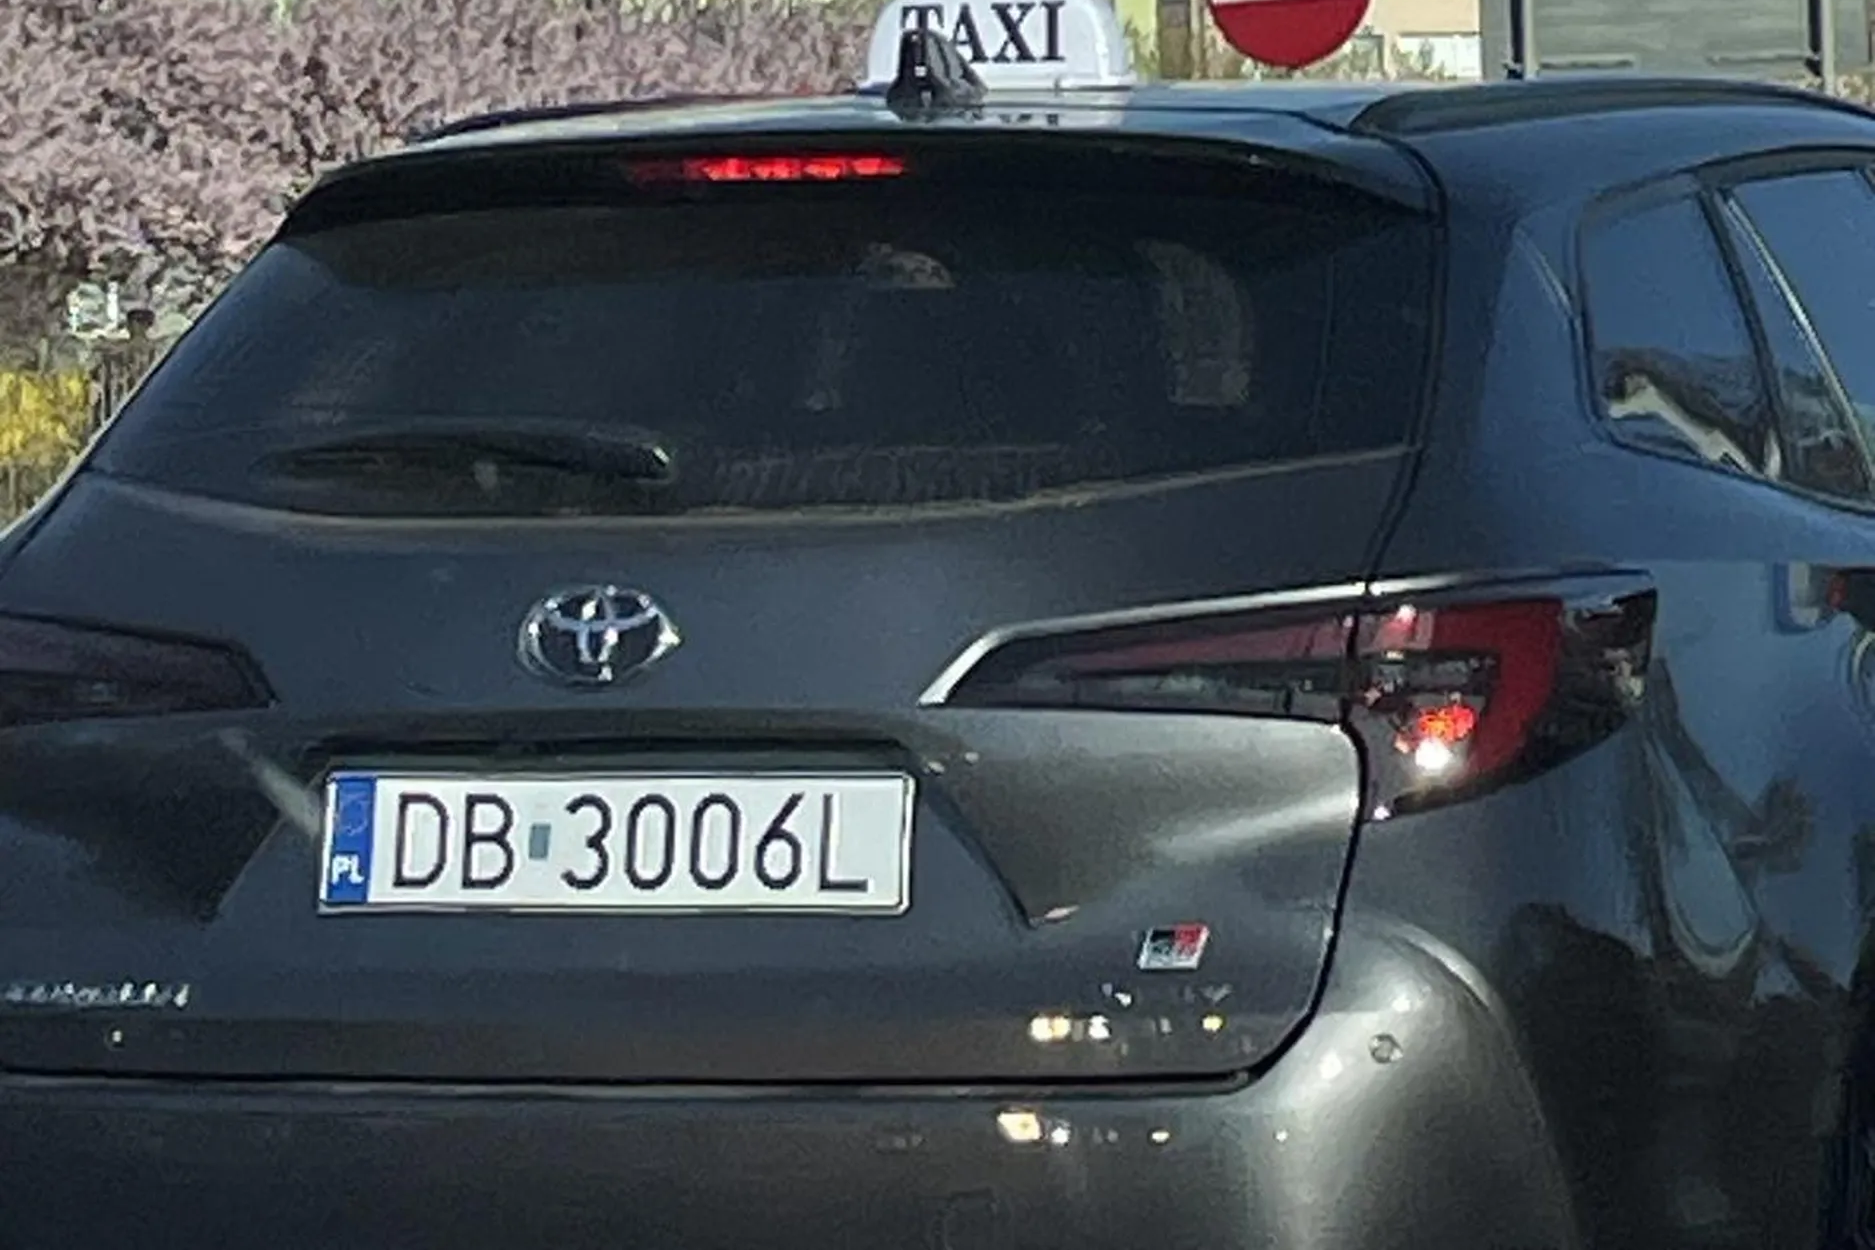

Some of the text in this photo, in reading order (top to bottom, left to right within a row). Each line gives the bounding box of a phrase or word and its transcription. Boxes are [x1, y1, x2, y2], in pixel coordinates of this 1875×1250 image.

[901, 0, 1066, 63] TAXI
[332, 853, 365, 885] PL
[392, 791, 870, 892] DB 3006L
